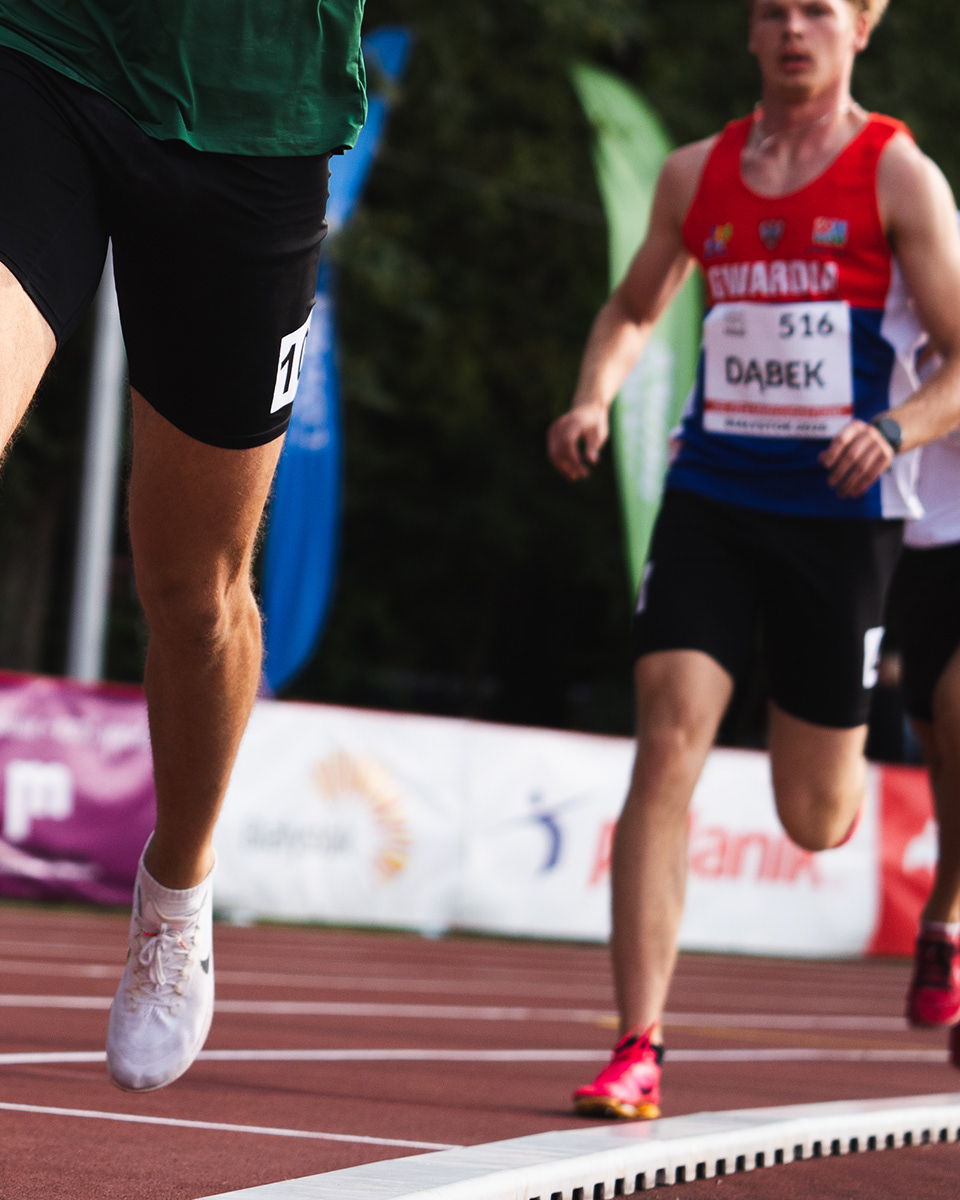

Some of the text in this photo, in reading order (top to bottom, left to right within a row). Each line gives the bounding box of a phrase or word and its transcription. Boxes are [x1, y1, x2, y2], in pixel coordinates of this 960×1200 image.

[778, 312, 835, 338] 516
[280, 328, 309, 395] 1
[724, 354, 826, 394] DĄBEK
